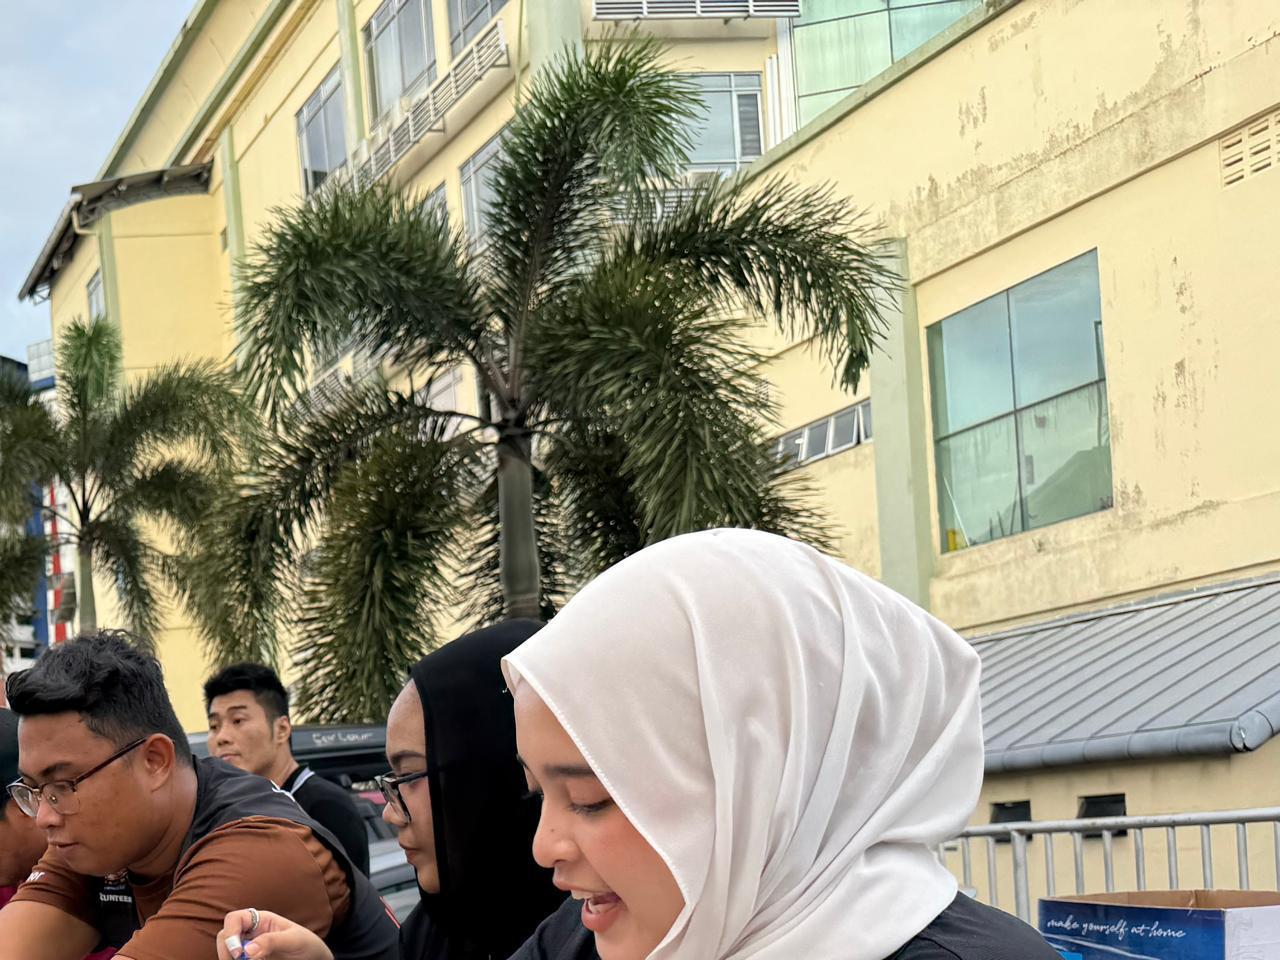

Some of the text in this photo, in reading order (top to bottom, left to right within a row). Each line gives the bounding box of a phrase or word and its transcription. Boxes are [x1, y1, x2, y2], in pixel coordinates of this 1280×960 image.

[1047, 914, 1186, 940] make yourself at home
